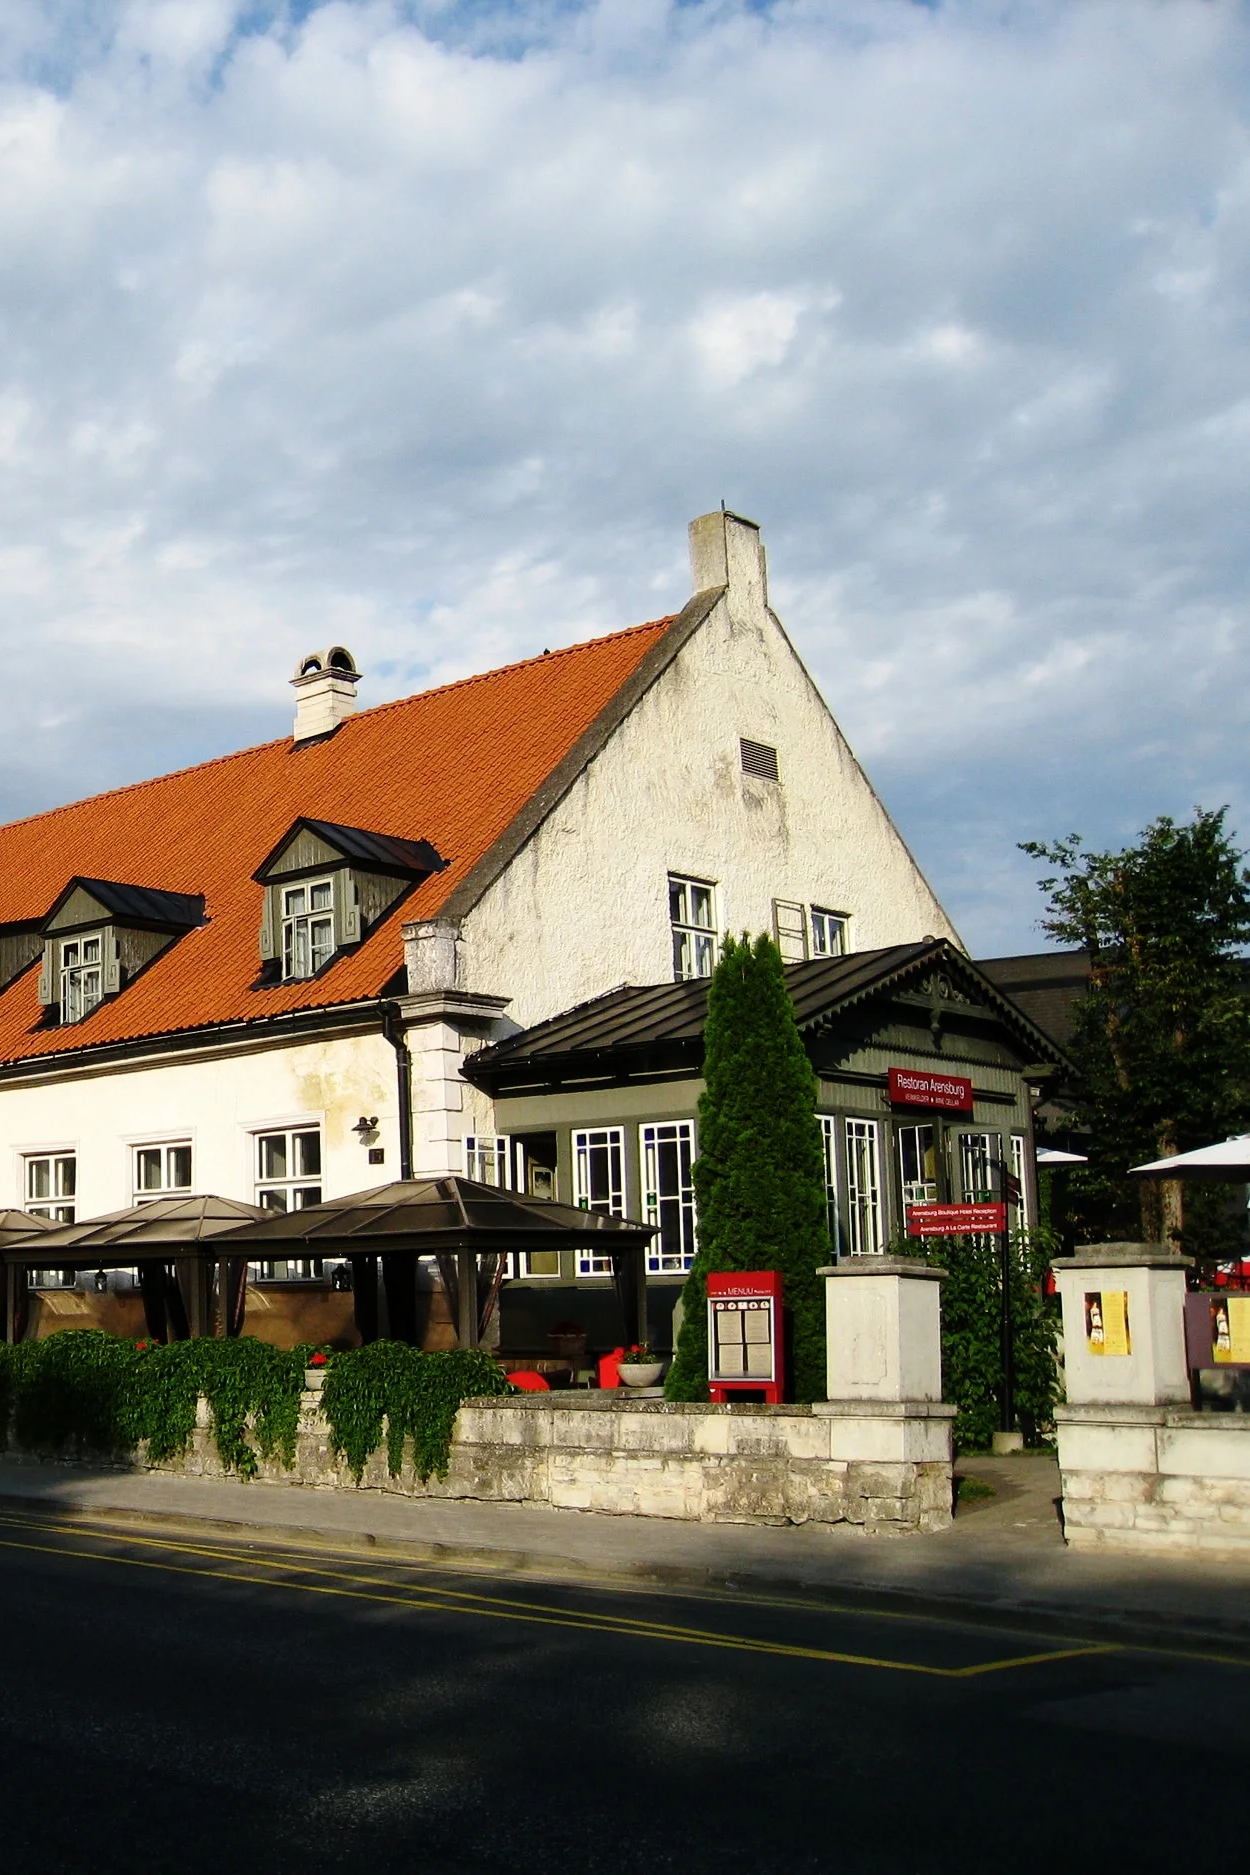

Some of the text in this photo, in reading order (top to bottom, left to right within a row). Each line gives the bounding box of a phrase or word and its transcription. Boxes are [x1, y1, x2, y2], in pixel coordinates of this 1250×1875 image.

[897, 1074, 965, 1099] Restoran Arensburg
[727, 1287, 754, 1295] MENUU
